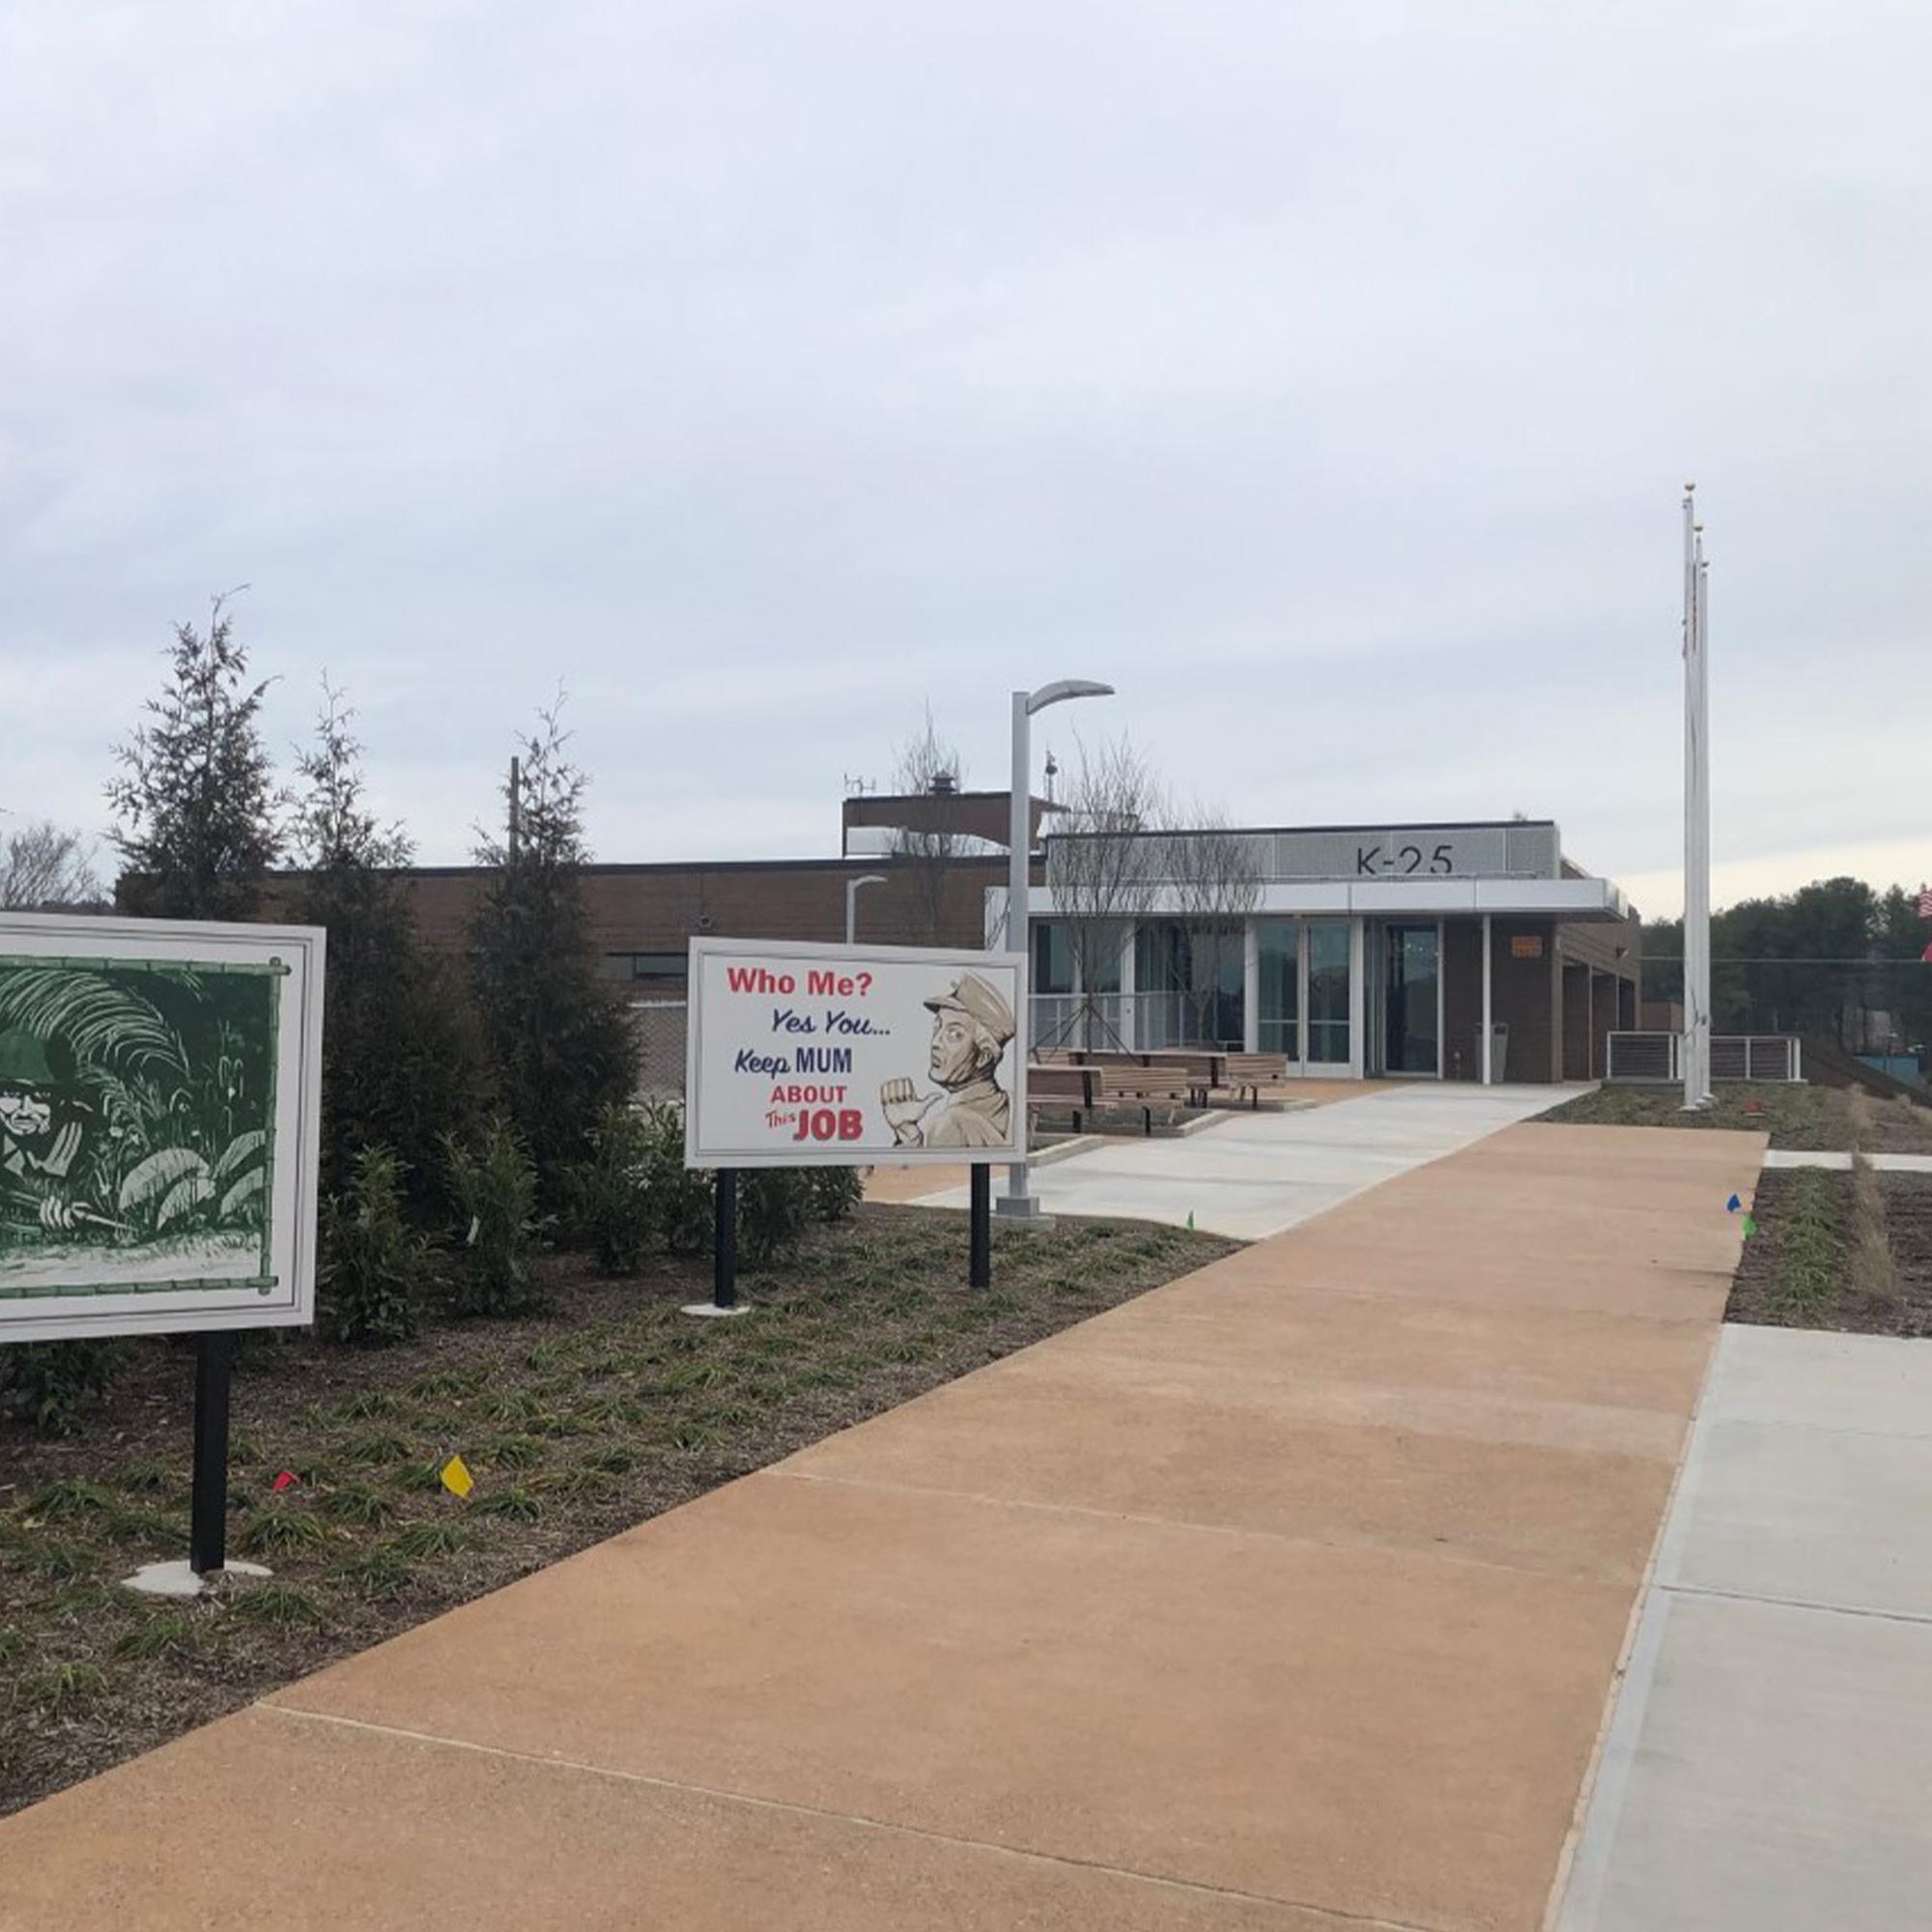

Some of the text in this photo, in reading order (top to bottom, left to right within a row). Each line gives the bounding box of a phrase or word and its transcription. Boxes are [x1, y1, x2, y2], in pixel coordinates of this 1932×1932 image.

[1356, 845, 1453, 875] K-25
[726, 967, 872, 997] Who Me?
[772, 1009, 891, 1036] Yes You...
[734, 1047, 852, 1080] Keep MUM
[771, 1085, 847, 1103] ABOUT
[765, 1109, 863, 1141] This JOB
